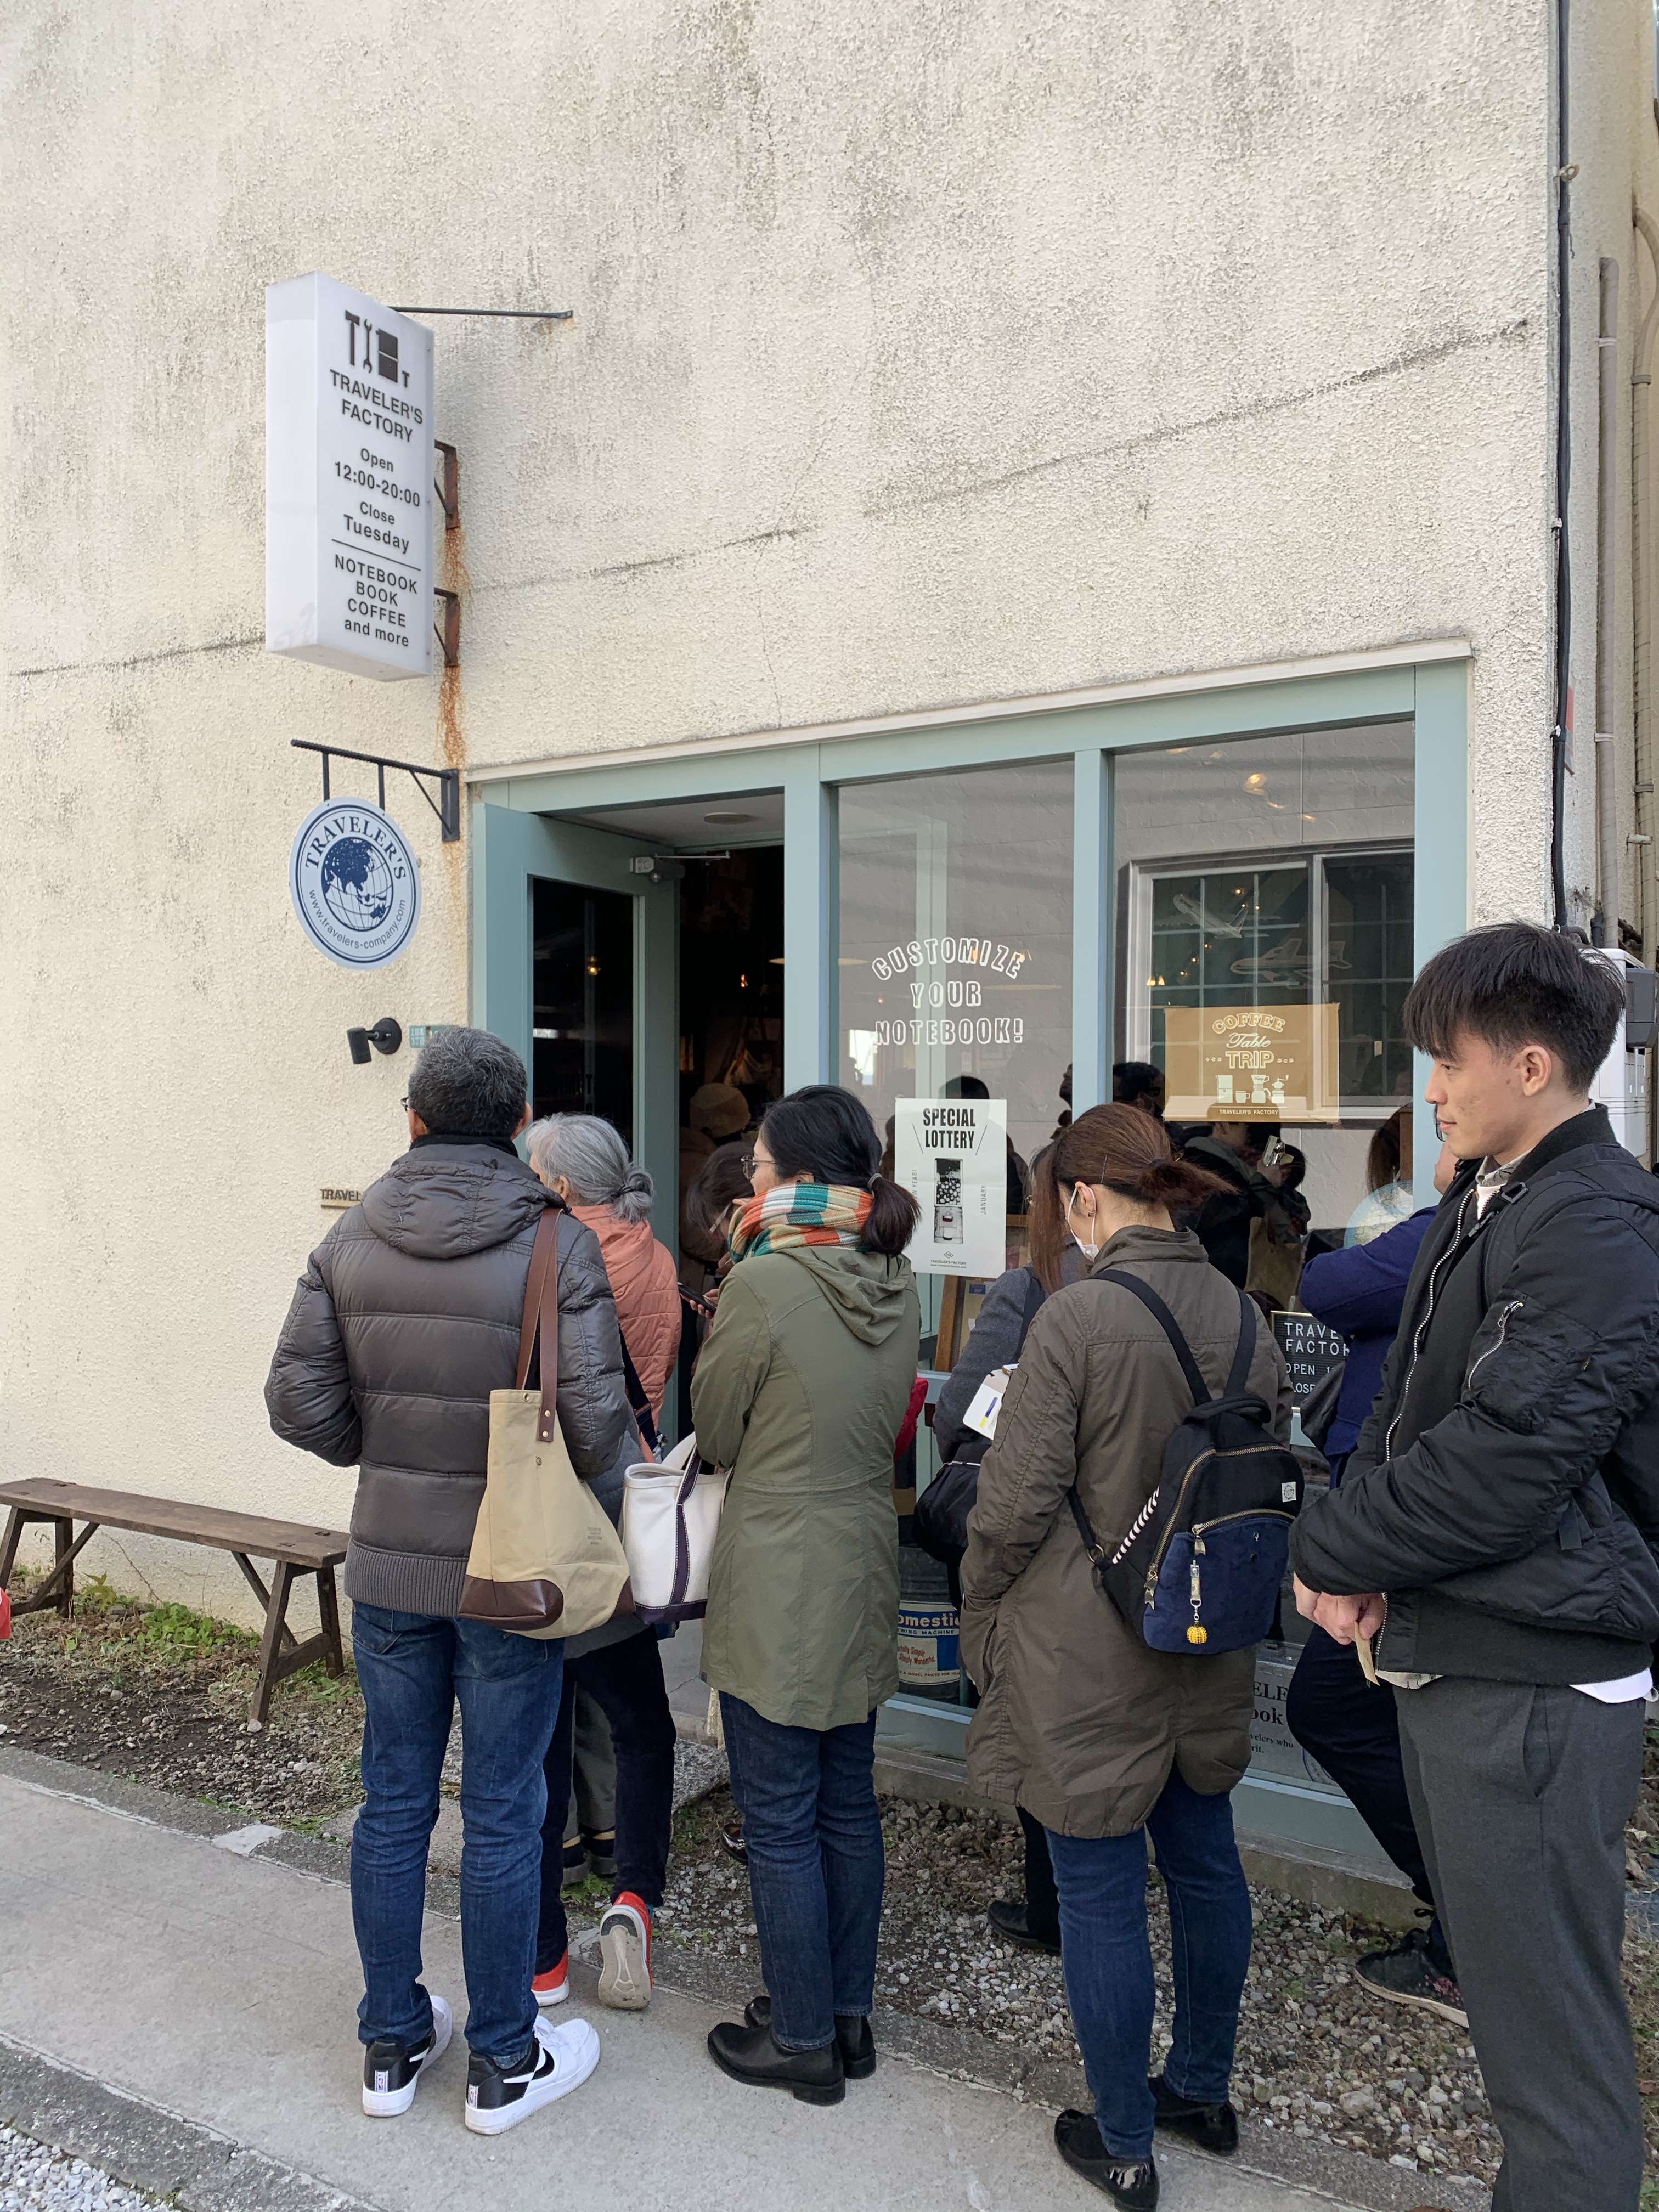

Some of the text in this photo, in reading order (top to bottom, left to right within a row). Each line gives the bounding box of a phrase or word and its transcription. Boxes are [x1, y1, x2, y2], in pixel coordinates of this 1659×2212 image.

[330, 369, 423, 425] TRAVELER'S
[342, 401, 414, 442] FACTORY
[360, 448, 394, 473] Open
[335, 461, 420, 507] 12:00-20:00
[360, 501, 395, 524] Close
[343, 516, 409, 554] Tuesday
[335, 555, 417, 594] NOTEBOOK
[356, 581, 398, 606] BOOK
[348, 598, 406, 628] COFFEE
[345, 618, 409, 647] and more
[305, 816, 406, 879] TRAVELER'S
[309, 889, 406, 949] www.travelers-company.com
[872, 936, 1025, 980] CUSTOMIZE
[910, 981, 981, 1009] YOUR
[875, 1017, 1023, 1046] NOTEBOOK!
[1212, 1013, 1286, 1034] COFFEE
[1226, 1032, 1271, 1048] Table
[1225, 1050, 1274, 1069] TRIP
[922, 1108, 976, 1127] SPECIAL
[924, 1128, 975, 1149] LOTTERY
[1286, 1363, 1315, 1376] OPEN
[1277, 1739, 1294, 1748] who
